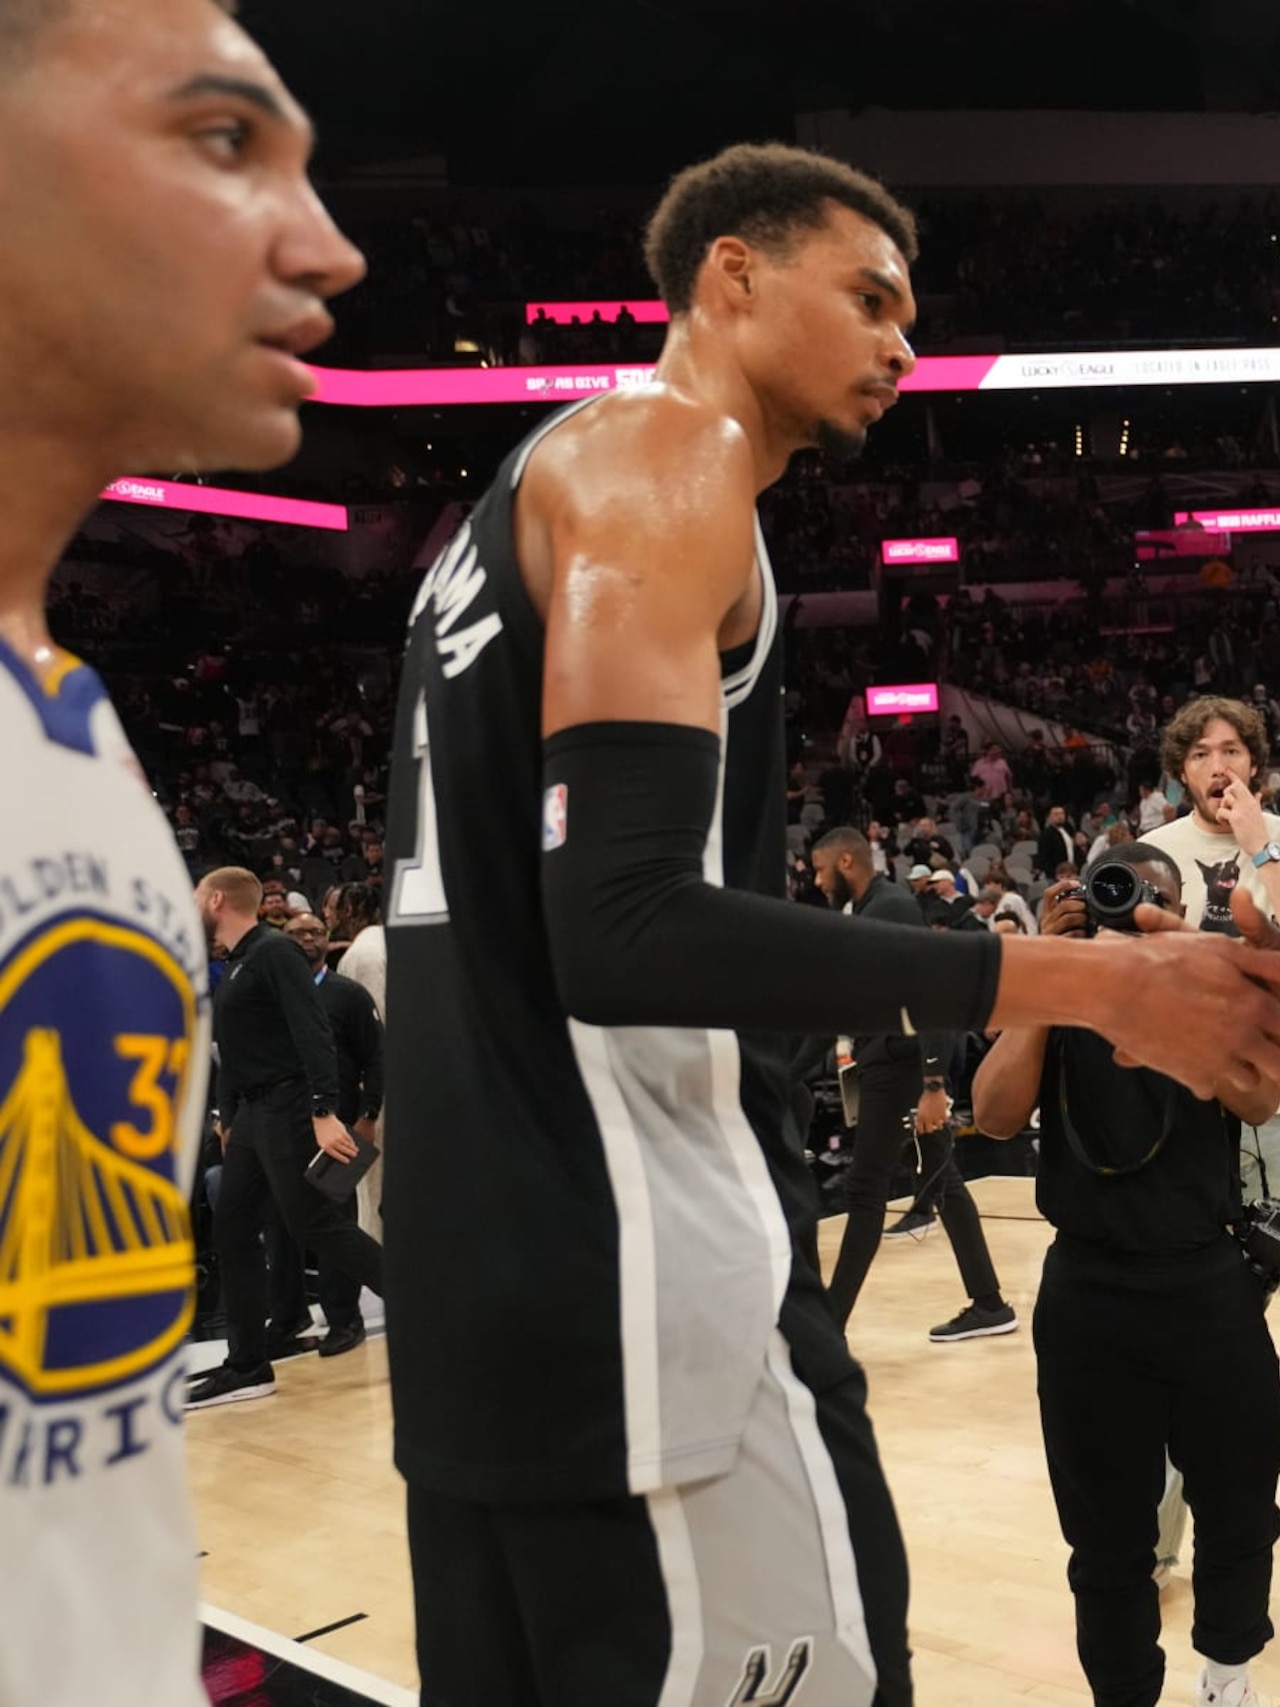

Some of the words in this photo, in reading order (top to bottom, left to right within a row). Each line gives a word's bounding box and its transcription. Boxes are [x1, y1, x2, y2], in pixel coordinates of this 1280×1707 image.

[1020, 364, 1059, 377] LUCKY
[1078, 363, 1115, 376] EAGLE
[575, 376, 609, 389] GIVE
[131, 483, 165, 497] EAGLE
[0, 853, 110, 938] LDEN
